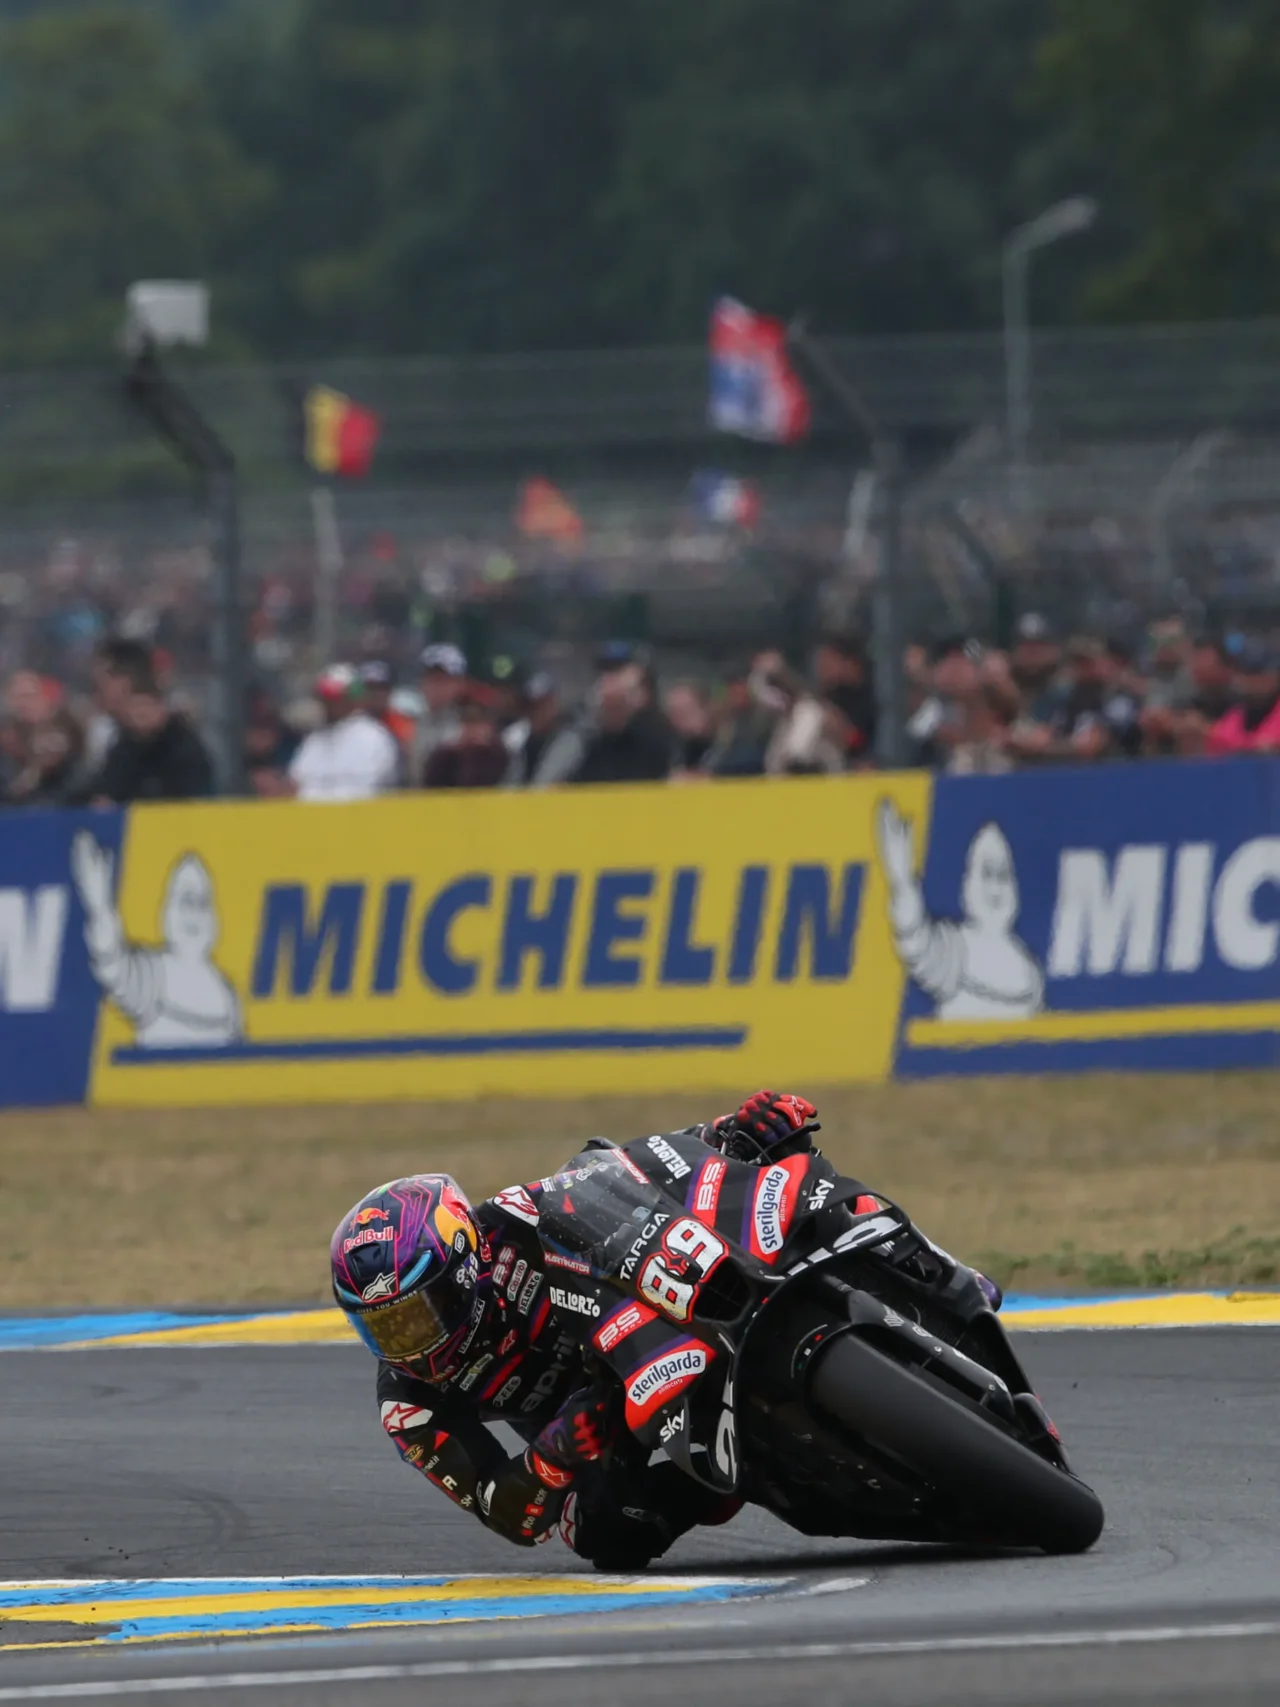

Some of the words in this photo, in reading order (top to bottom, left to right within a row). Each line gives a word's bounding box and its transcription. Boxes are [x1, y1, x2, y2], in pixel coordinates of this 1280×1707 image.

[1047, 834, 1280, 979] MIC
[250, 861, 871, 1001] MICHELIN
[647, 1135, 692, 1179] DELLORTO
[697, 1162, 720, 1211] BS
[809, 1178, 835, 1211] sky
[756, 1170, 783, 1250] sterilgarda
[343, 1230, 364, 1254] Red
[364, 1225, 394, 1244] Bull
[620, 1212, 670, 1280] TARGA
[637, 1216, 729, 1325] 89
[549, 1286, 600, 1317] DELLORTO
[598, 1307, 641, 1348] BS
[632, 1351, 701, 1401] sterilgarda
[658, 1378, 684, 1395] alimenti
[659, 1409, 685, 1443] sky
